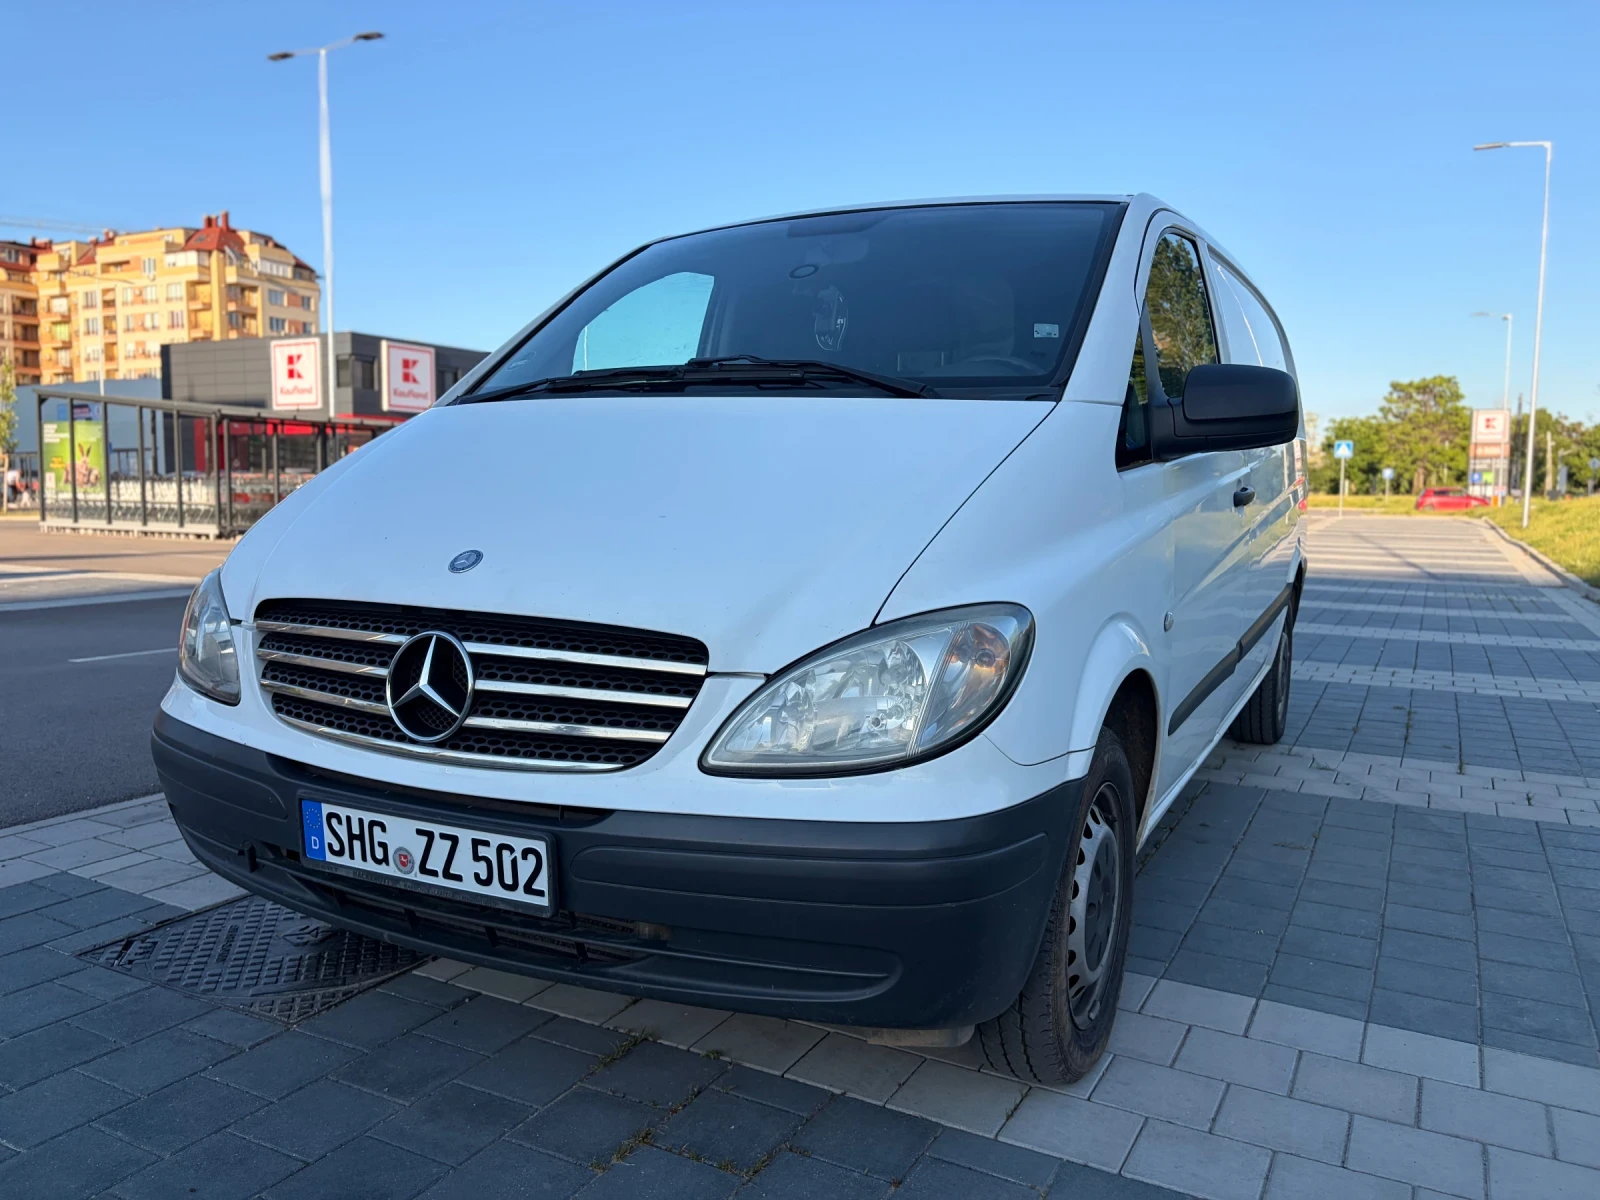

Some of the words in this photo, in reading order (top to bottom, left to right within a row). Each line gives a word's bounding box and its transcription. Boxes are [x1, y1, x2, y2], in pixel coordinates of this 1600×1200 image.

[287, 353, 304, 379] K
[402, 358, 420, 384] K
[280, 385, 313, 396] Kaufland
[393, 387, 428, 400] Kaufland
[311, 835, 320, 850] D
[325, 811, 390, 867] SHG
[415, 827, 463, 882] ZZ
[471, 837, 545, 897] 502
